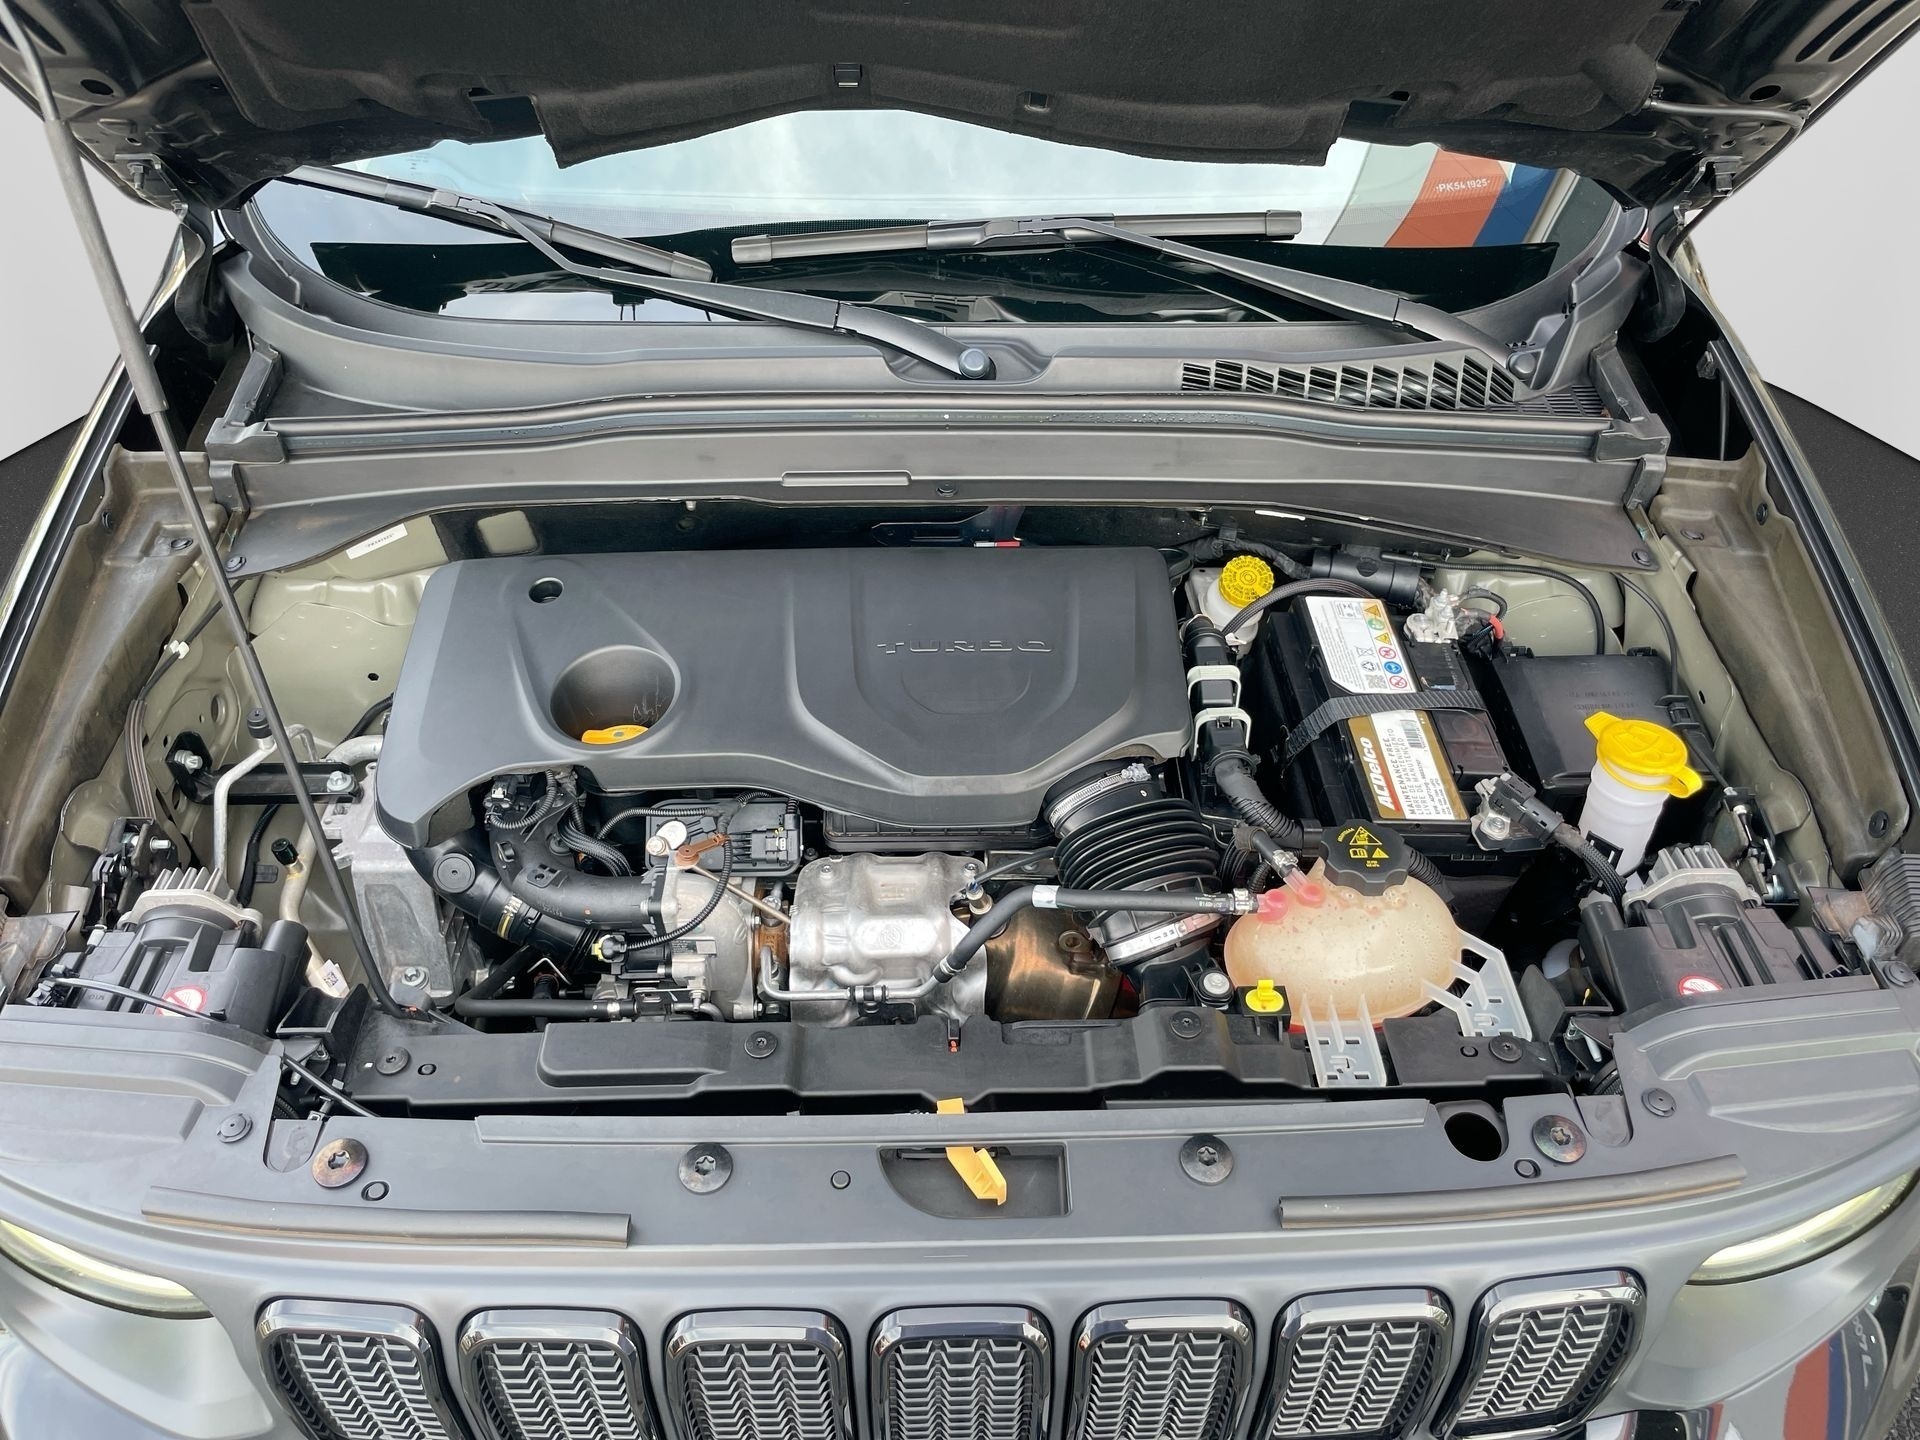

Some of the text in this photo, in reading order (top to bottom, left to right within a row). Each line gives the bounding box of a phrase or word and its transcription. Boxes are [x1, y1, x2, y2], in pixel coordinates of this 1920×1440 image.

[876, 639, 1053, 655] TURBO
[1360, 737, 1396, 811] ACDelco
[1382, 738, 1416, 815] MAINTENANCE FREE
[1387, 728, 1412, 782] MANTENIMIENTO
[1396, 737, 1420, 782] MANUTENÇÃO
[1411, 795, 1425, 815] LIBRE
[1418, 795, 1432, 815] LIVRE
